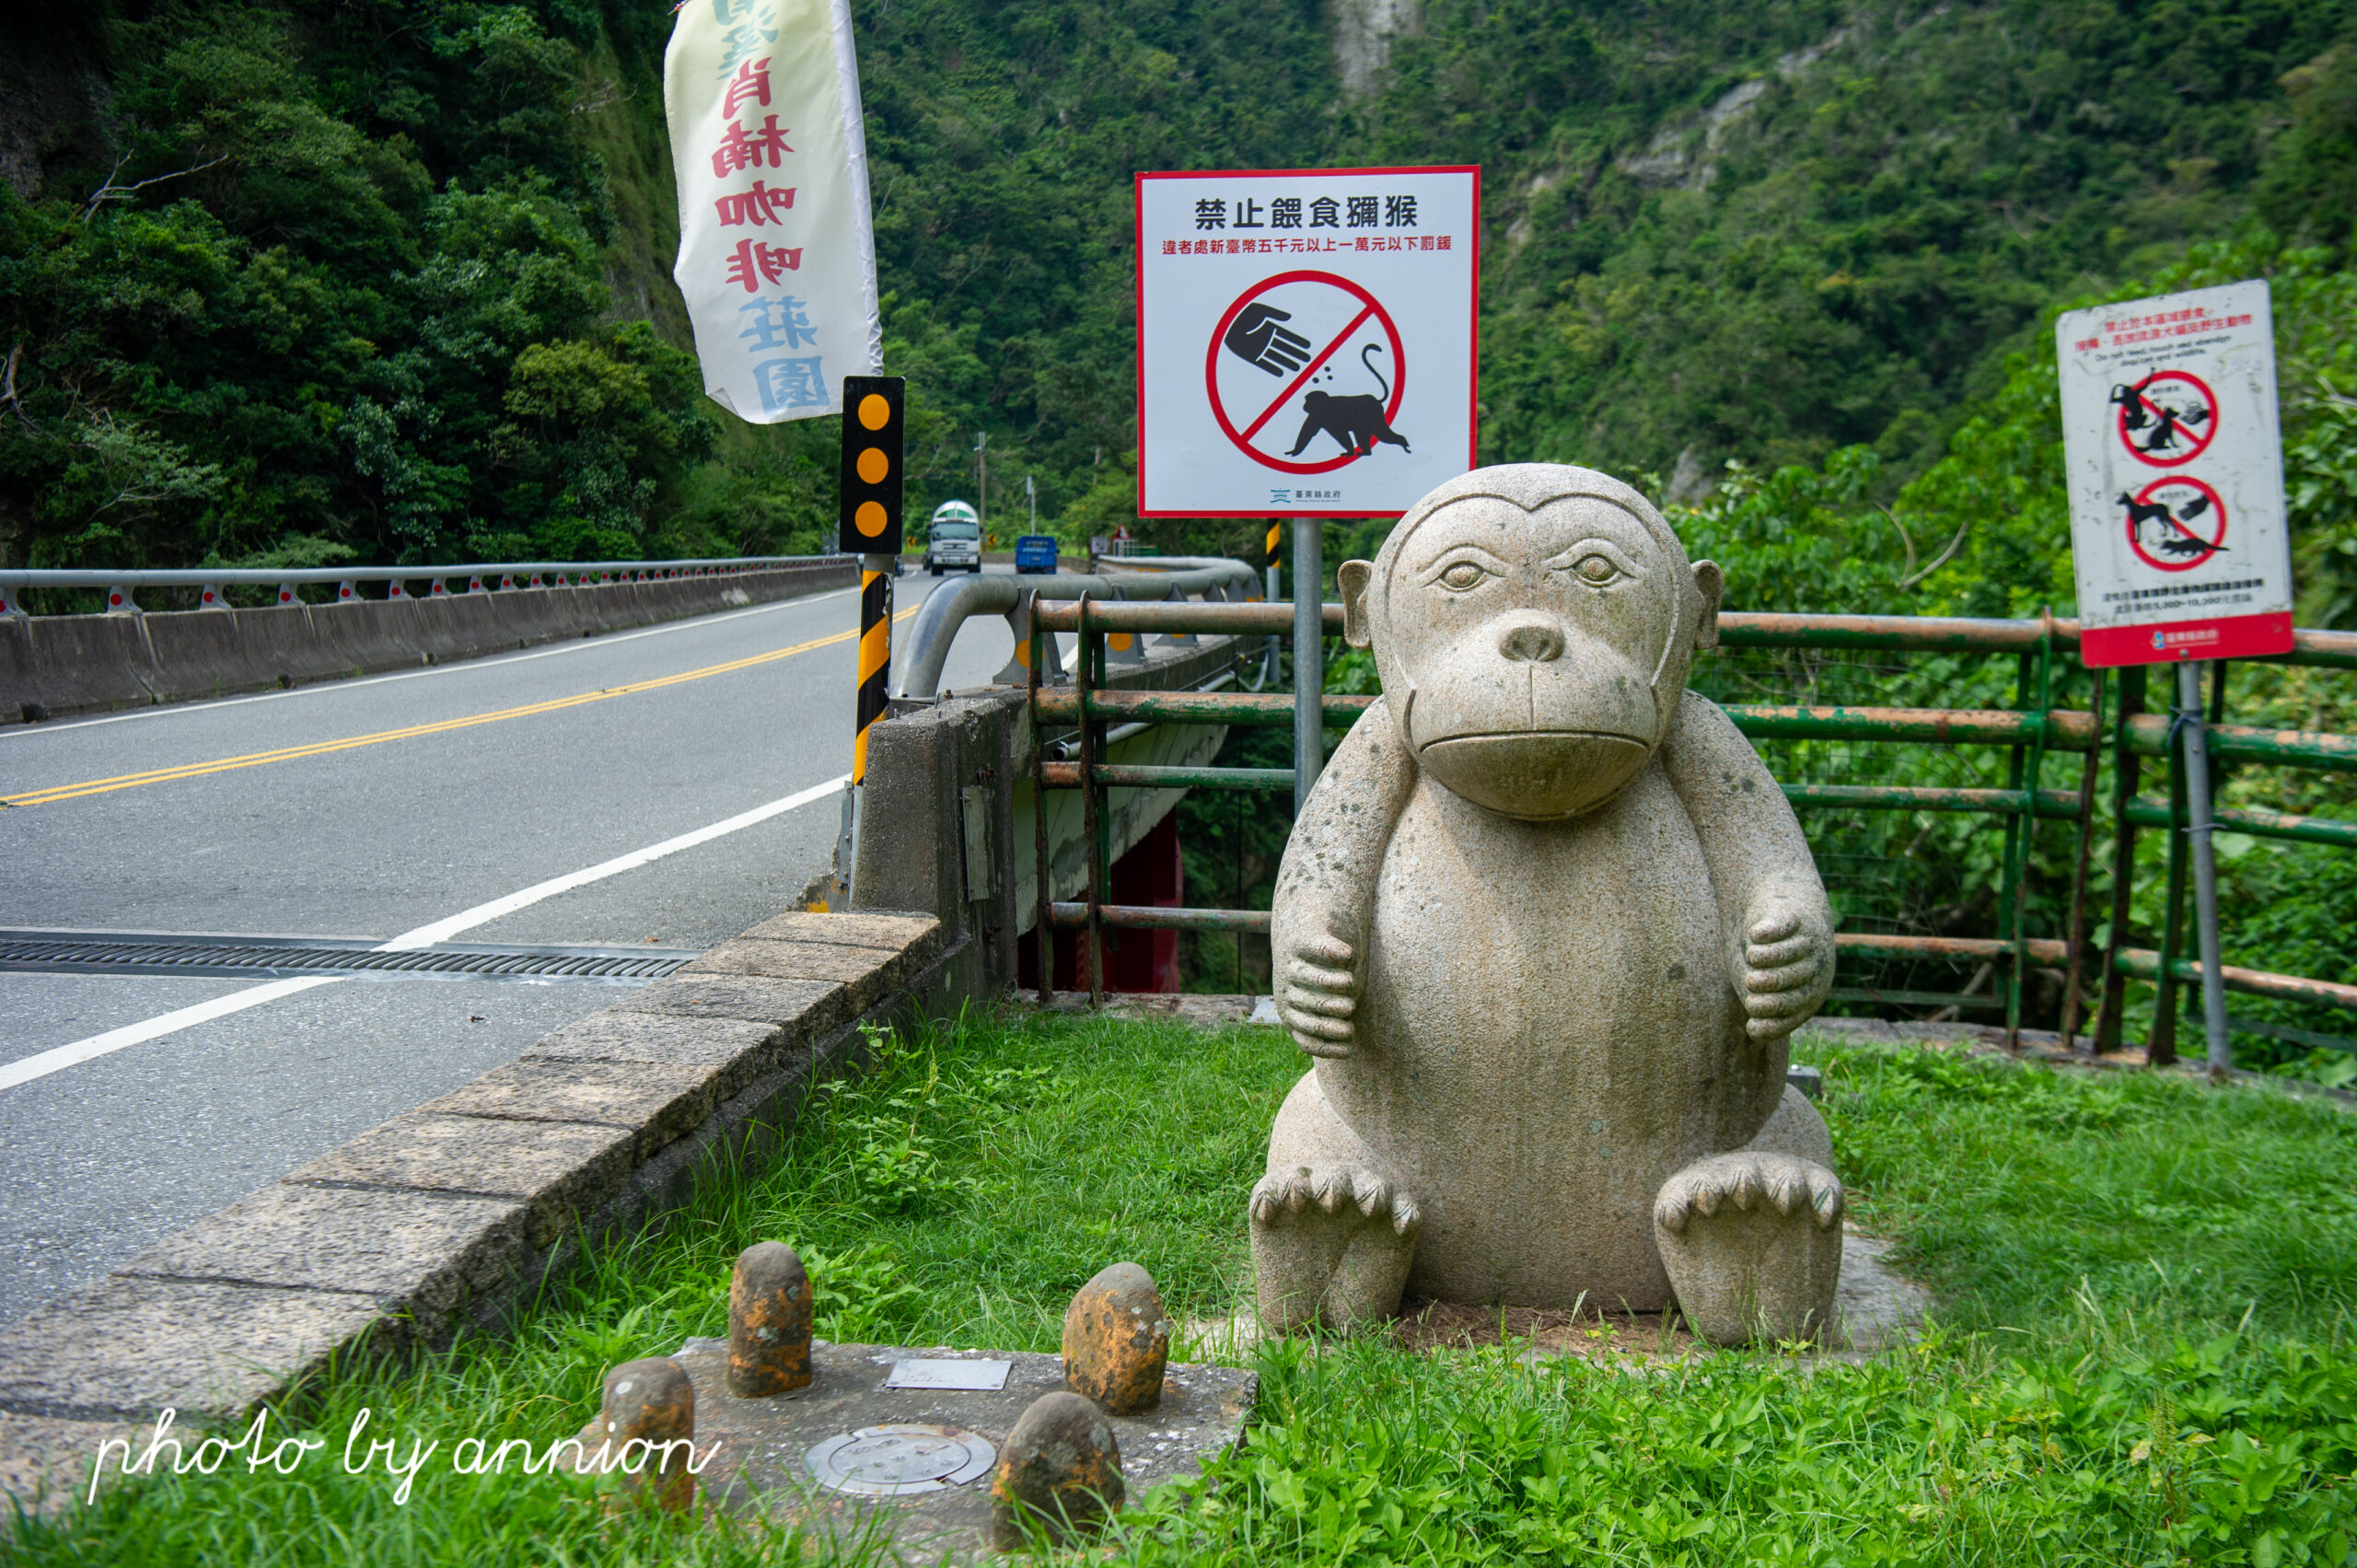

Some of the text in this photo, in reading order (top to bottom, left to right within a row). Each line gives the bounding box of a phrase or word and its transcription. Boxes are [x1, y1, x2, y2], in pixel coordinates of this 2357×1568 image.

[1195, 195, 1418, 230] 禁止餵食獼猴
[1162, 236, 1452, 255] 違者處新臺幣五千元以上一萬元以下罰鍰
[1295, 490, 1341, 499] 臺東縣政府
